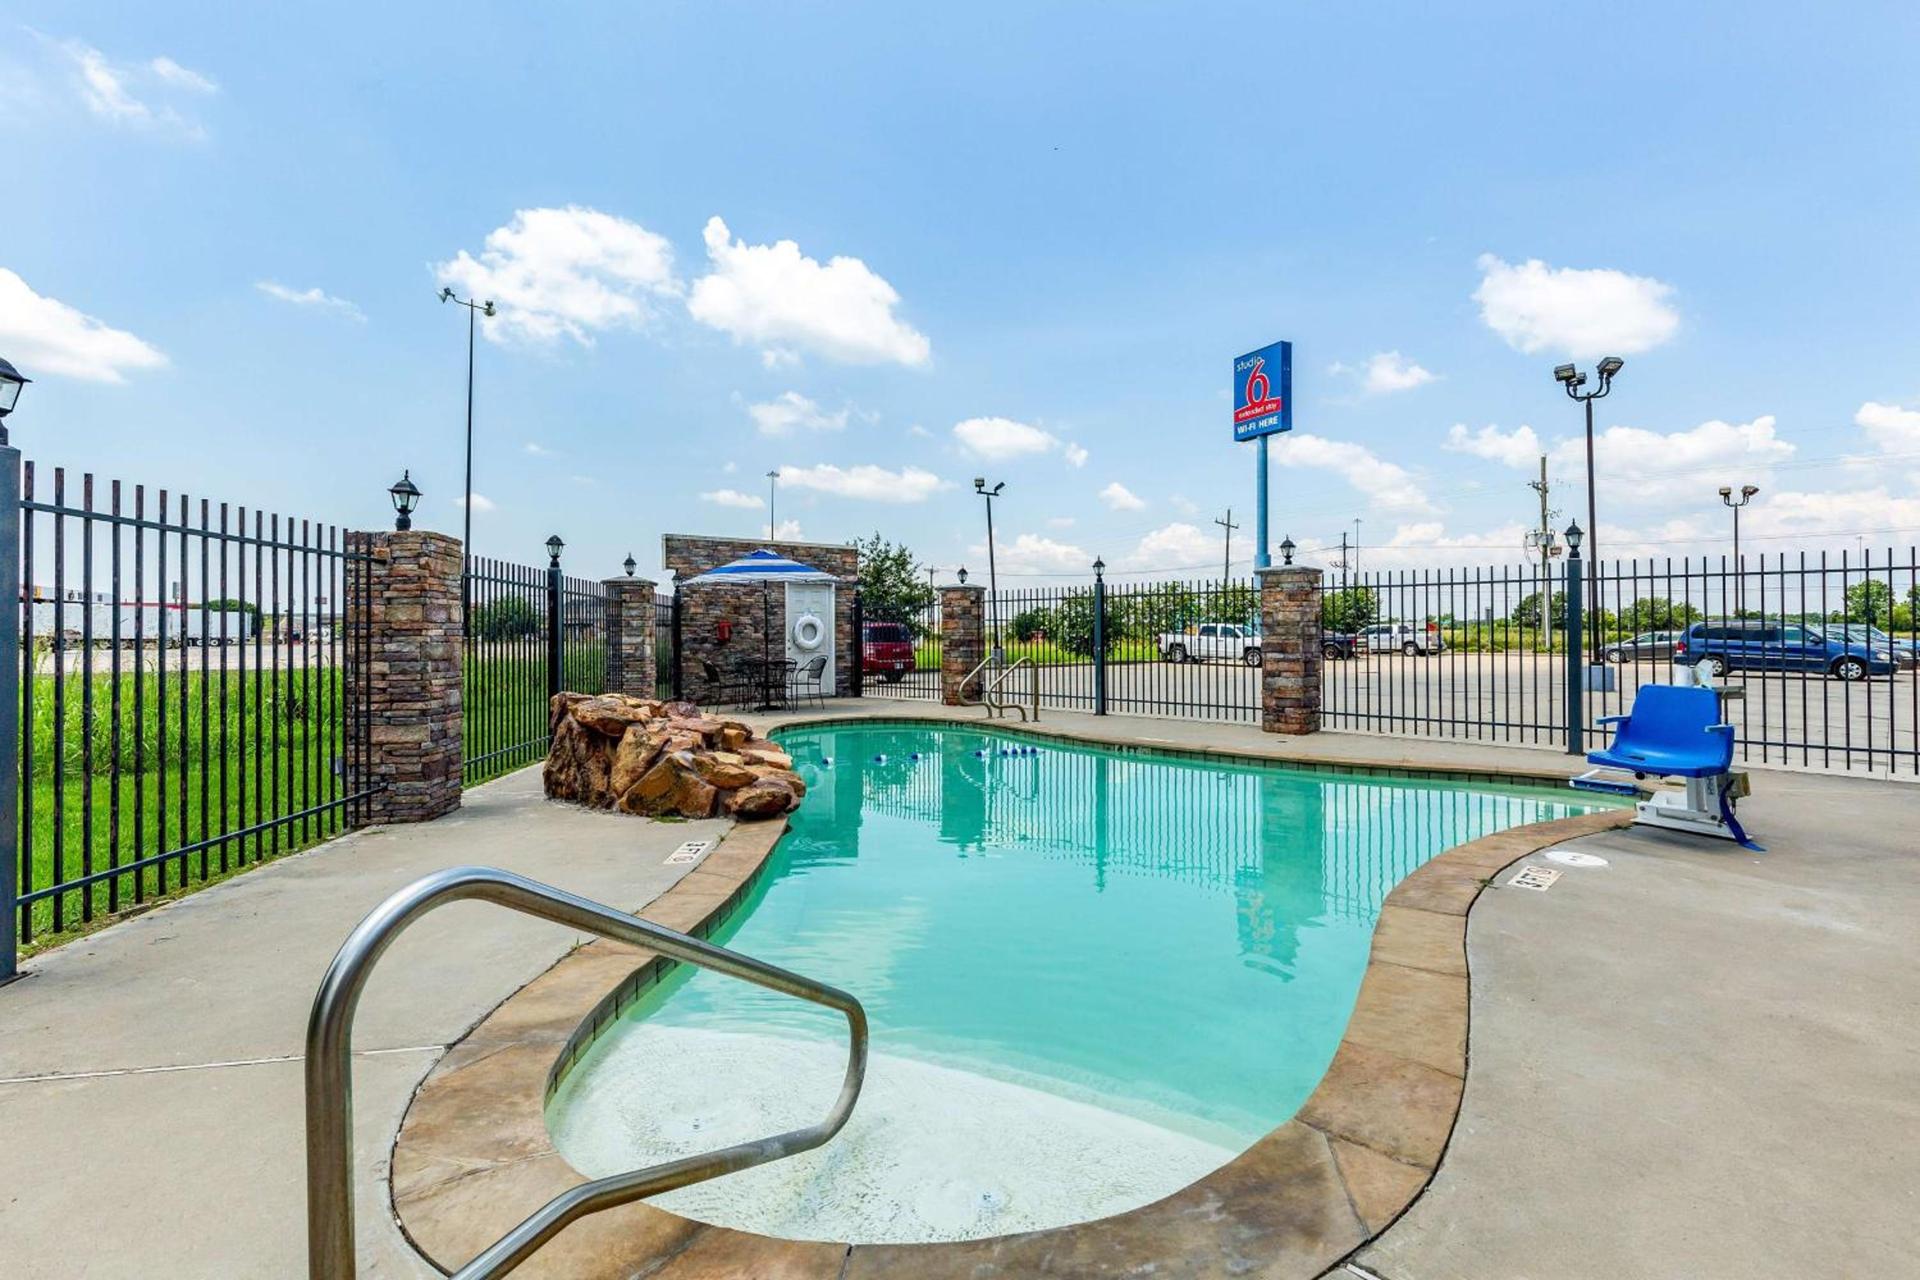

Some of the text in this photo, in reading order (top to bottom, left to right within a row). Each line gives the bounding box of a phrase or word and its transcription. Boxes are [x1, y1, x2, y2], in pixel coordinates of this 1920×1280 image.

[1236, 356, 1262, 372] studio
[1246, 359, 1270, 406] 6
[1237, 415, 1278, 434] WI-FI HERE
